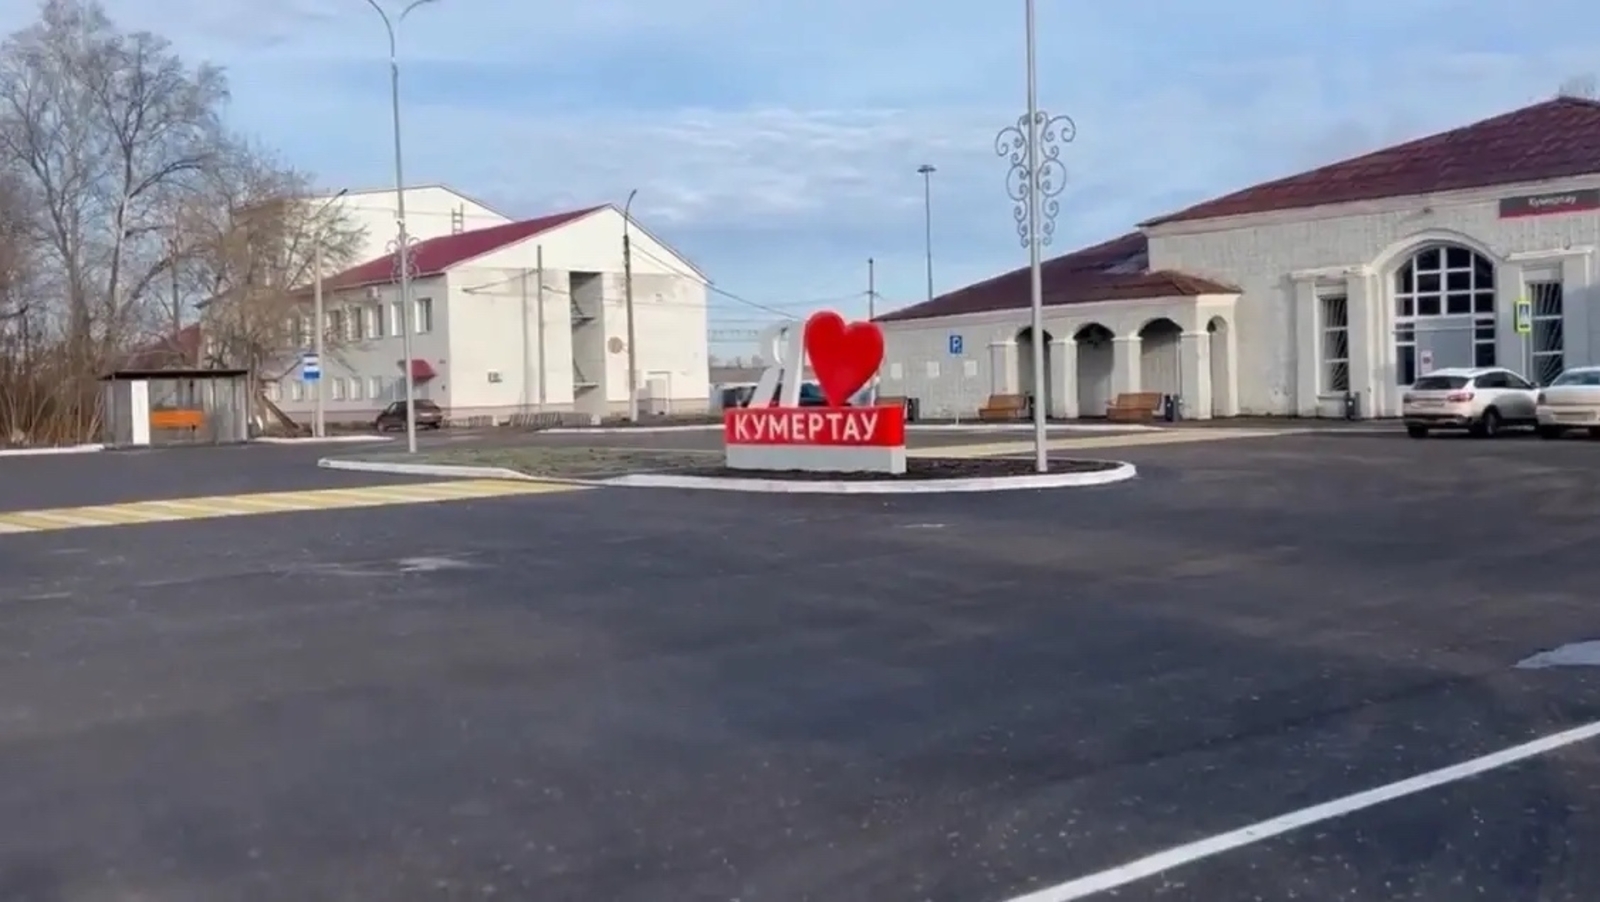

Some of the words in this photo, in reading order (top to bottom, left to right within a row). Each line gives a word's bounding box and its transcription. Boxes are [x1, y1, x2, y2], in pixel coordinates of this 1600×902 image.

[952, 336, 961, 353] P
[748, 319, 804, 408] Я
[735, 413, 878, 441] КУМЕРТАУ
